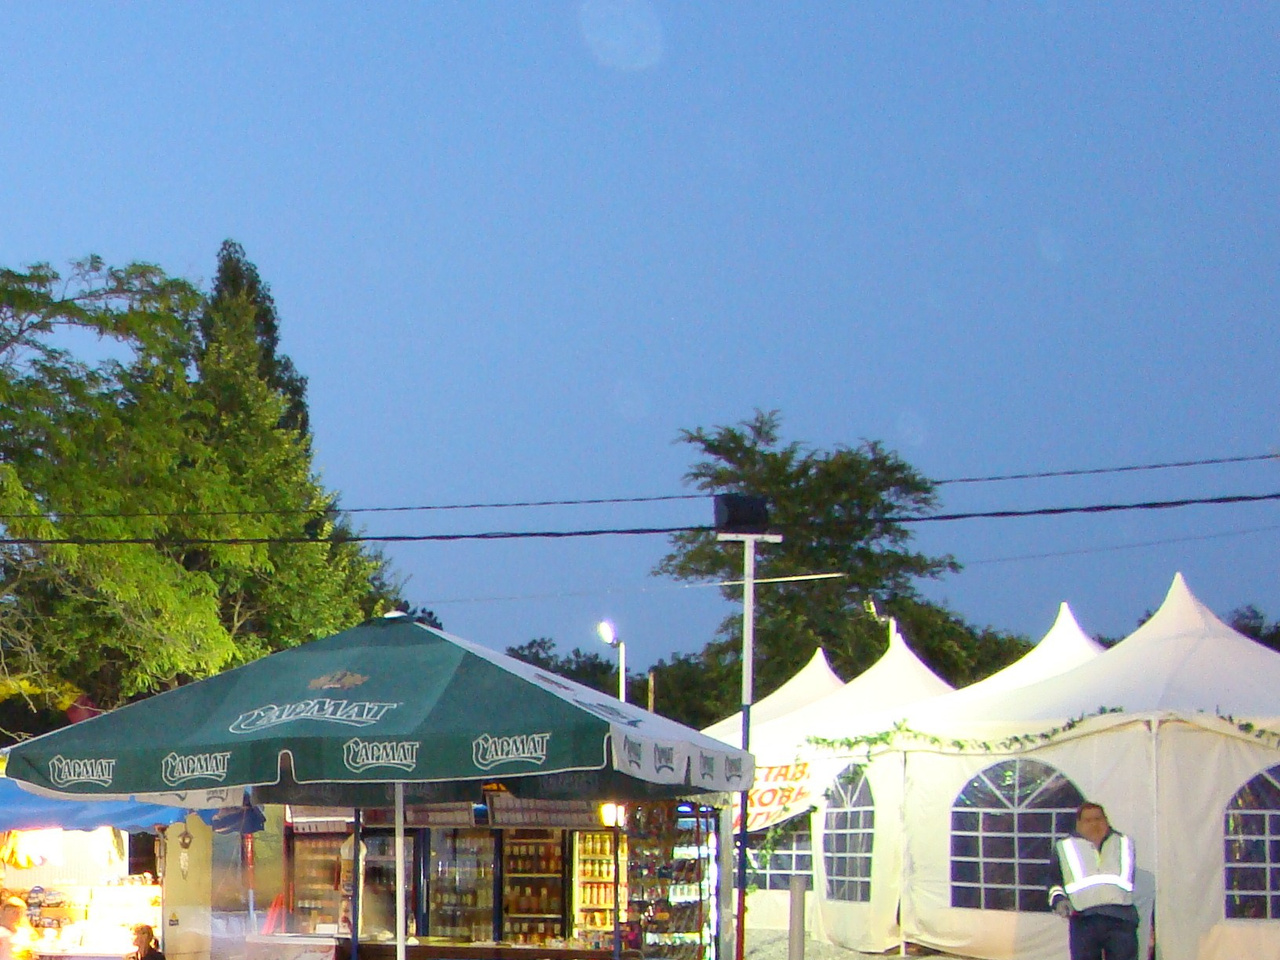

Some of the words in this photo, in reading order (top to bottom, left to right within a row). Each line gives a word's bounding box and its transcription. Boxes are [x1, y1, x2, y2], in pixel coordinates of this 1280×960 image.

[161, 752, 230, 786] САРМАТ
[343, 737, 419, 773] САРМАТ
[472, 733, 551, 770] САРМАТ
[49, 755, 115, 787] САРМАТ
